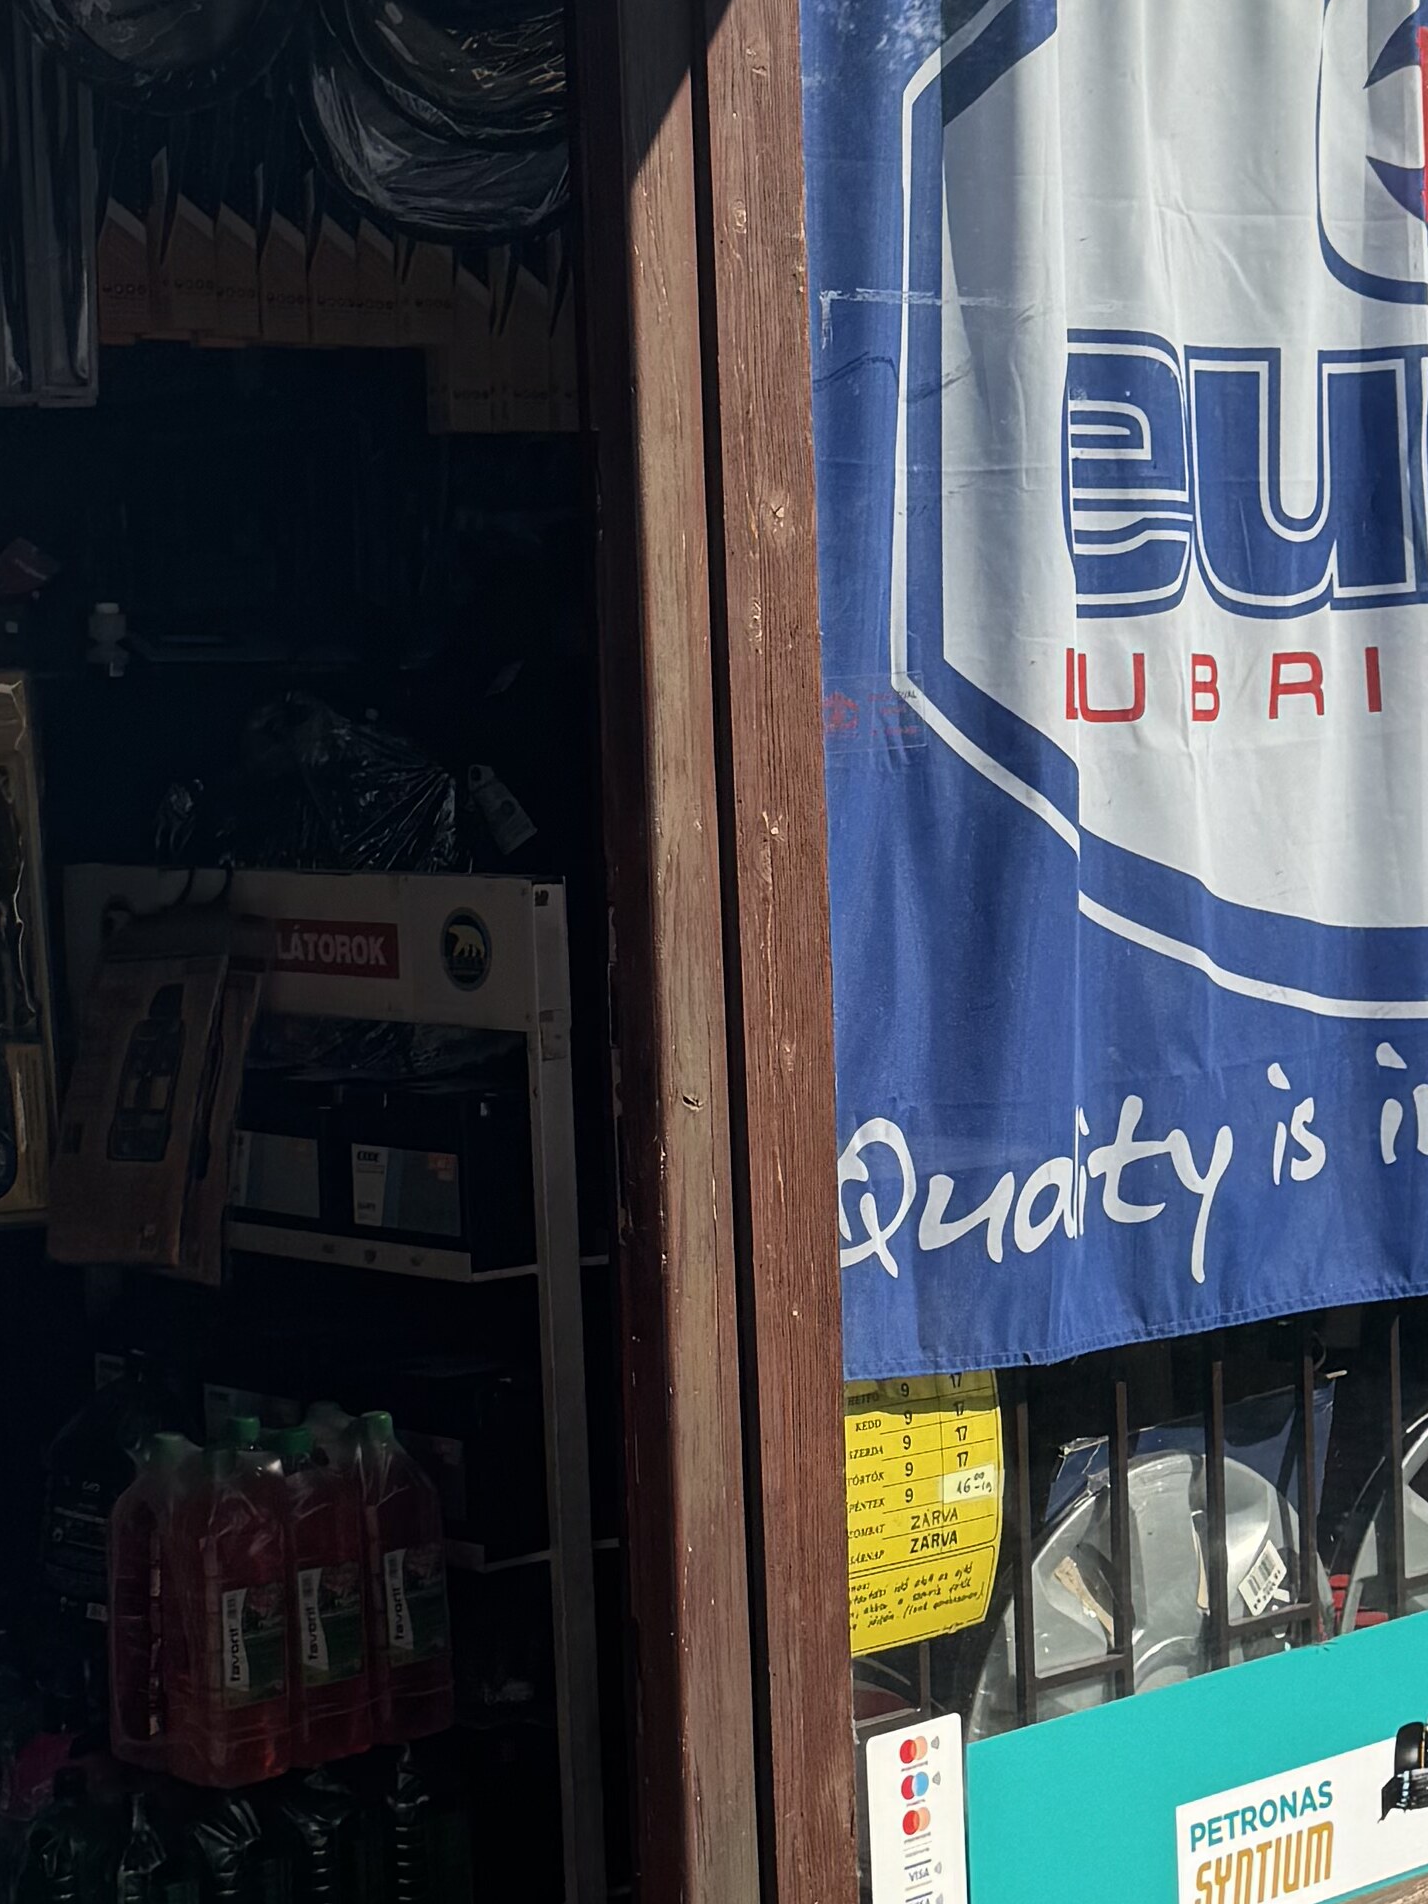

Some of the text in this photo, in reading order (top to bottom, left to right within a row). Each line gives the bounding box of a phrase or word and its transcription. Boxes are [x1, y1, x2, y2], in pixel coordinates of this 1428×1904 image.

[277, 925, 388, 966] LÁTOROK
[1267, 1062, 1326, 1186] is
[855, 1418, 882, 1432] KEDD
[903, 1435, 912, 1450] 9
[955, 1425, 968, 1442] 17
[905, 1462, 914, 1478] 9
[957, 1450, 969, 1468] 17
[905, 1487, 914, 1504] 9
[910, 1507, 958, 1531] ZÁRVA
[910, 1530, 958, 1554] ZÁRVA
[392, 1587, 405, 1640] favorit
[306, 1606, 319, 1660] favorit
[229, 1628, 241, 1682] favorit
[1190, 1780, 1333, 1853] PETRONAS
[908, 1867, 930, 1883] VISA
